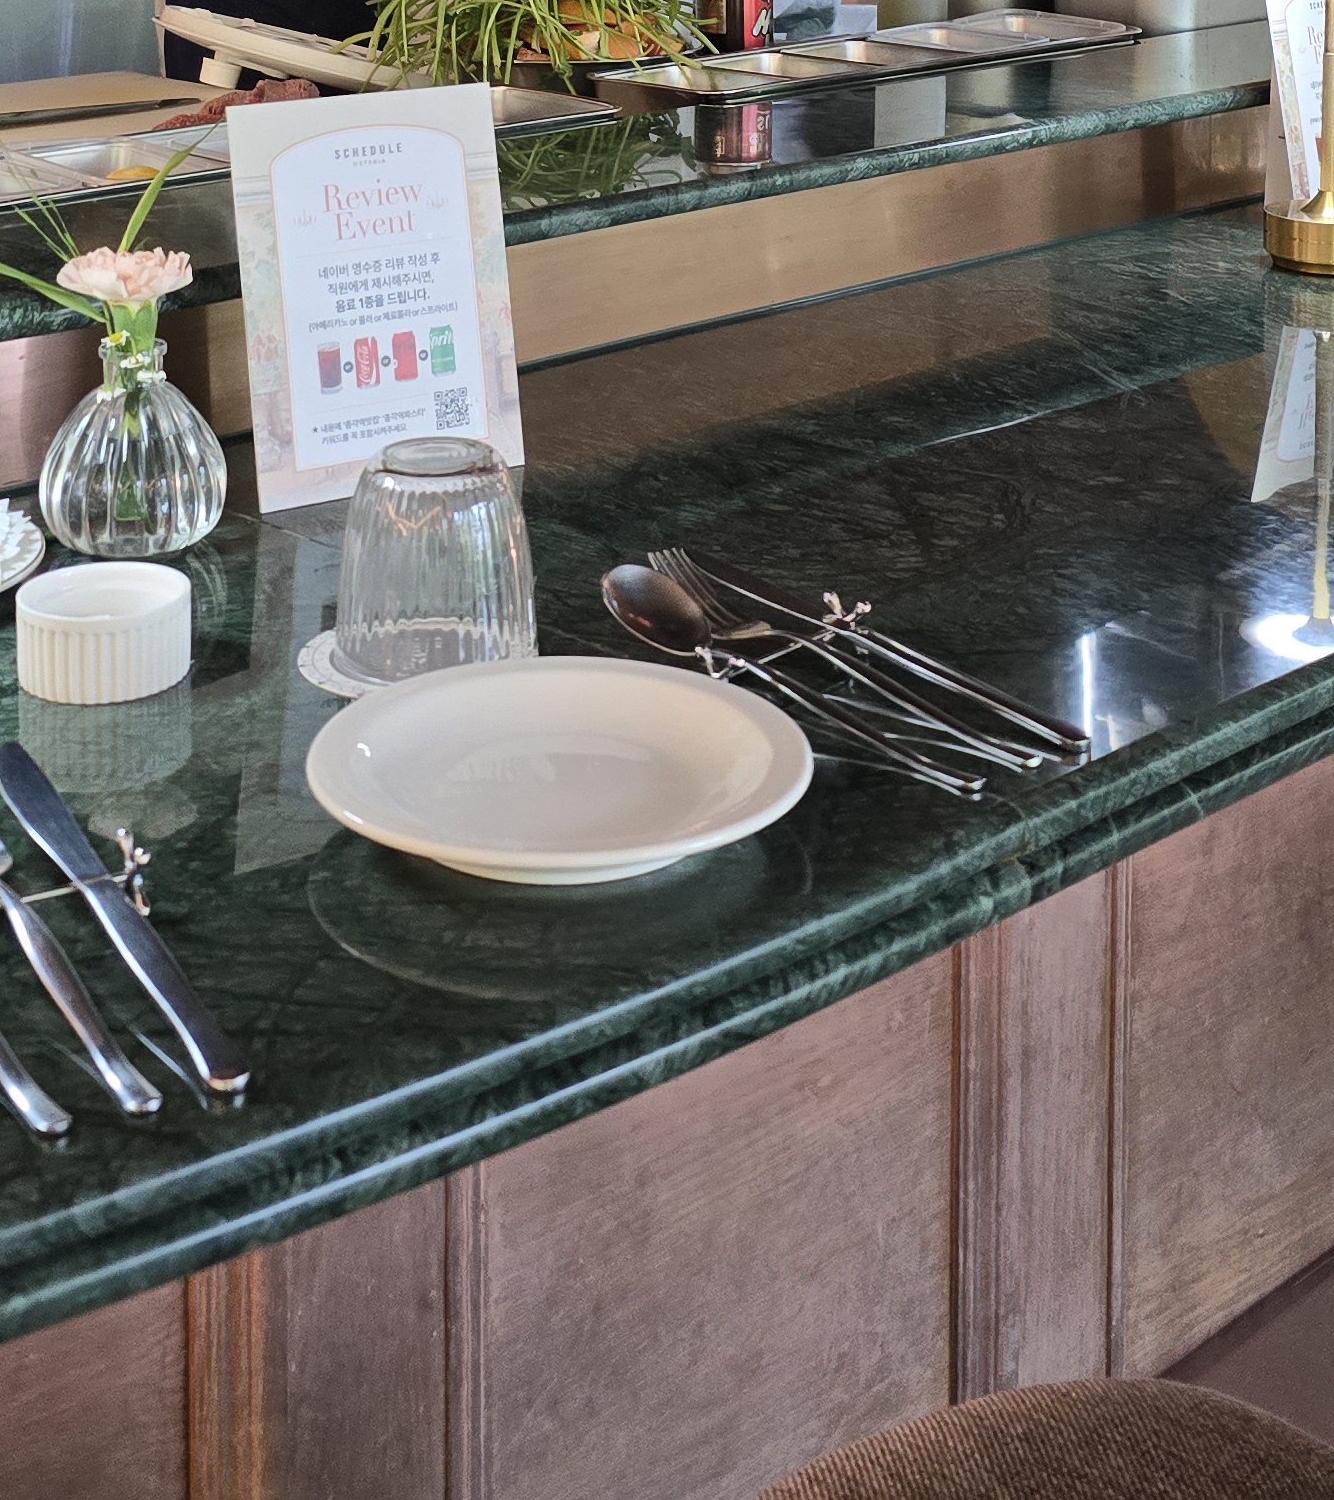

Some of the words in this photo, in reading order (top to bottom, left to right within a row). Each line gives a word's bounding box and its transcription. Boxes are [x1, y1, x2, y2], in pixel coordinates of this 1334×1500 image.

[334, 142, 403, 160] SCHEDULE
[322, 178, 423, 214] Review
[333, 210, 418, 241] Event
[318, 263, 349, 279] 네이버
[351, 260, 383, 276] 영수증
[385, 257, 406, 271] 리뷰
[407, 253, 428, 268] 작성
[430, 251, 441, 265] 후
[327, 278, 369, 296] 직원에게
[371, 269, 435, 289] 제시해주시면,
[335, 298, 357, 313] 음료
[358, 294, 385, 309] 1종을
[387, 287, 431, 304] 드립니다.
[349, 318, 357, 326] or
[374, 314, 382, 323] or
[412, 309, 420, 317] or
